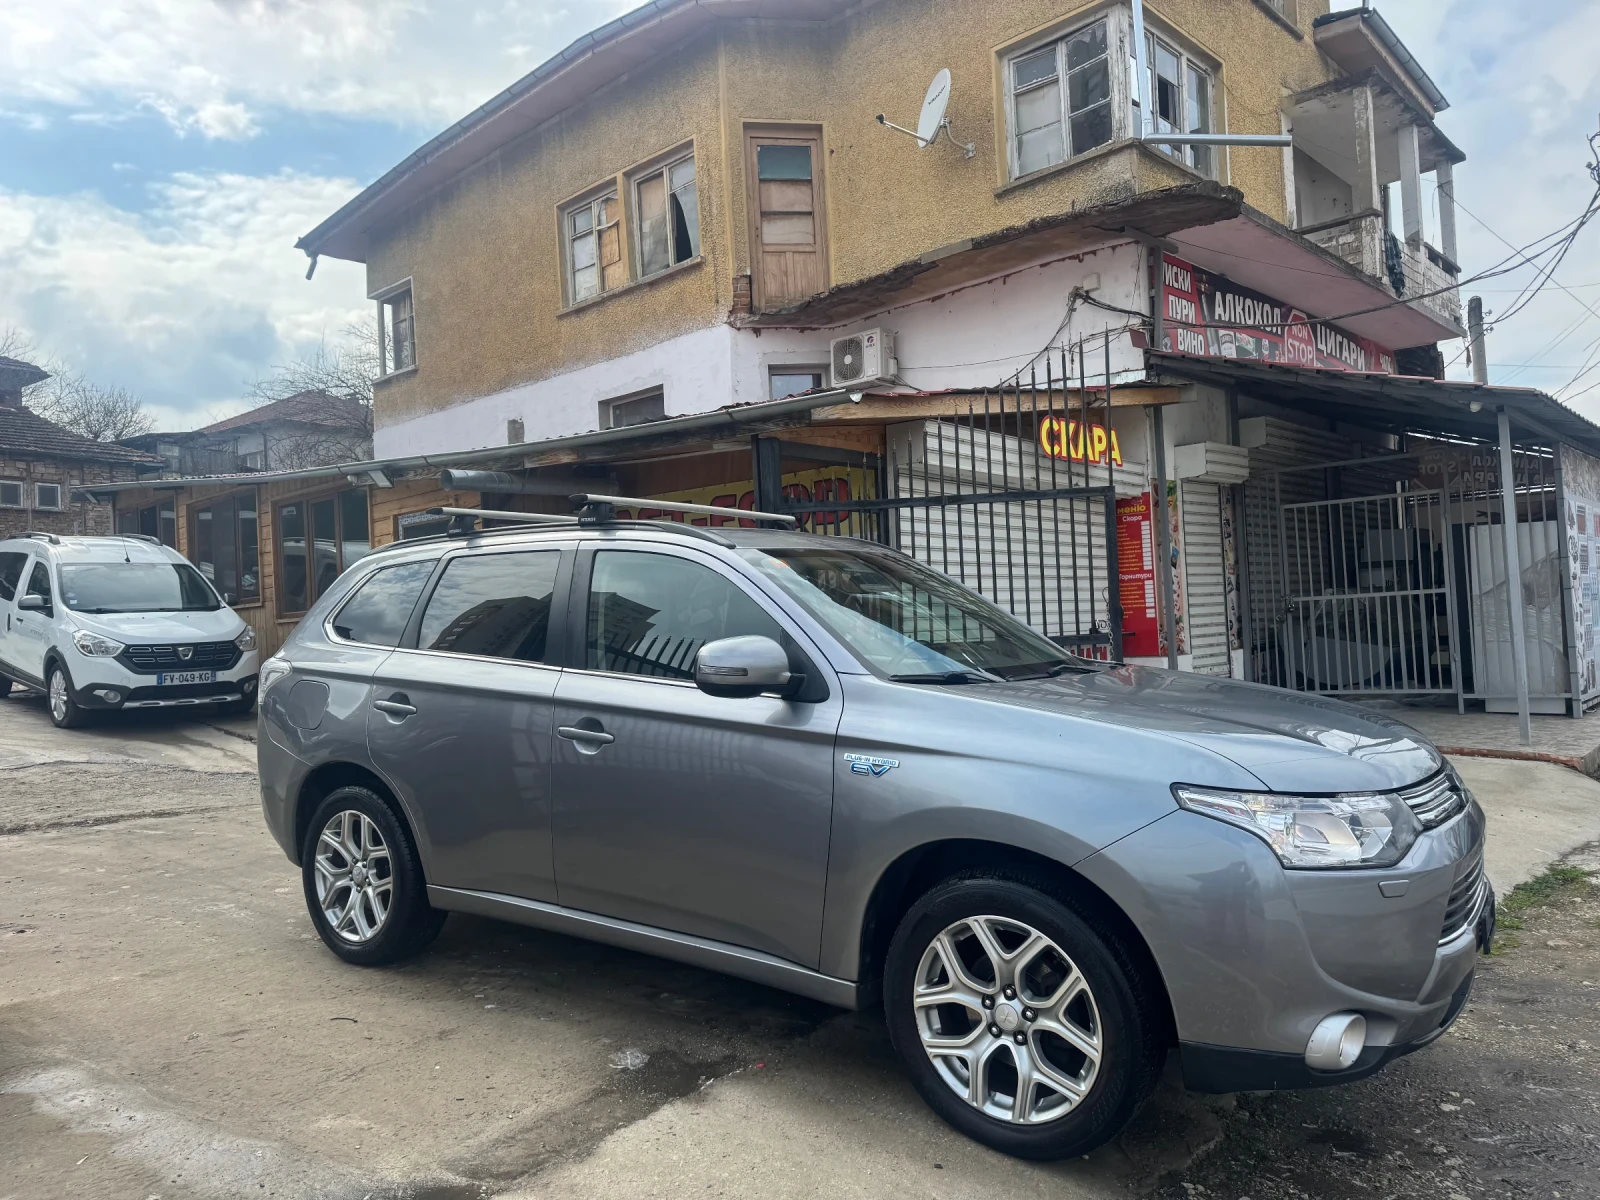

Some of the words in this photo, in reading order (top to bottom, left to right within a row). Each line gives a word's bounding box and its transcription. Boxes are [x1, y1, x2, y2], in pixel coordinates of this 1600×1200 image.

[1168, 294, 1196, 325] ПУРИ
[1215, 291, 1282, 335] АЛКОХОЛ
[1177, 328, 1205, 356] ВИНО
[1291, 321, 1308, 340] NON
[1287, 339, 1313, 367] STOP
[1317, 323, 1365, 372] ЦИГАРИ
[1040, 415, 1123, 467] СКАРА
[163, 672, 210, 684] FV-049-KG
